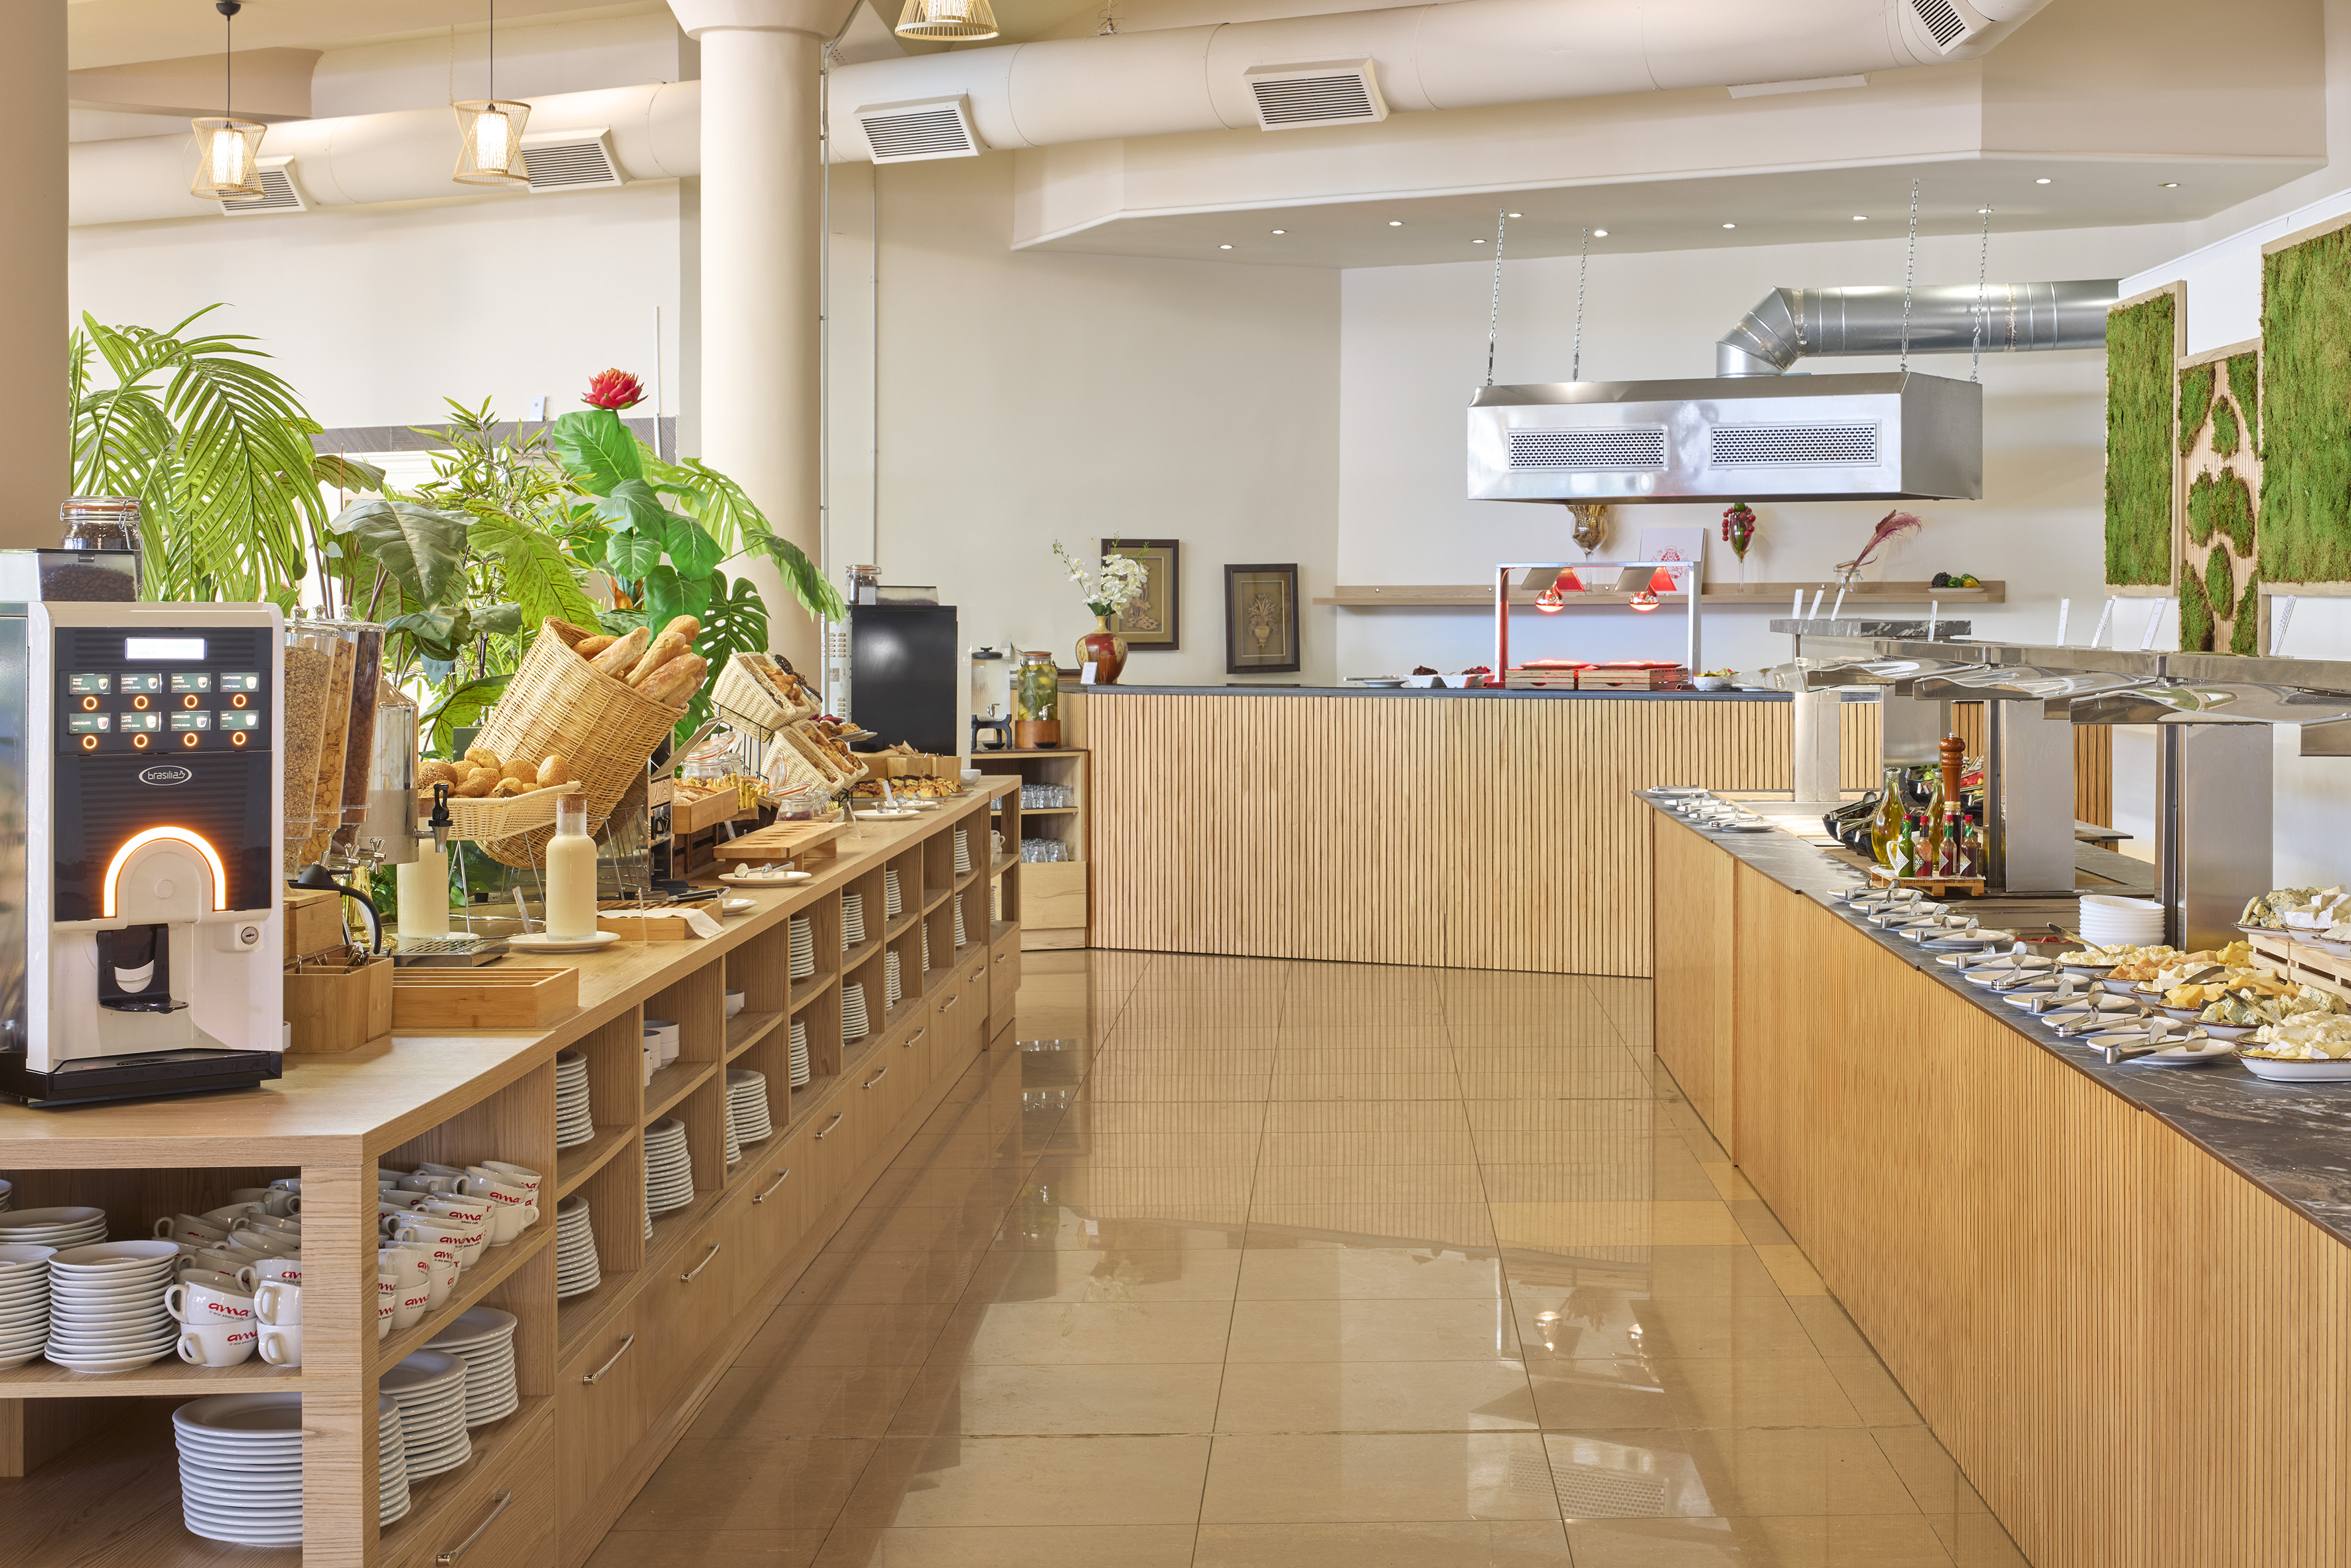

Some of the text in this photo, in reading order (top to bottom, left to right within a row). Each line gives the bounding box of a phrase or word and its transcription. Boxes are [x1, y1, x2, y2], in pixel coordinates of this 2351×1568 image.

[147, 770, 179, 780] brasilia
[490, 1192, 520, 1204] ama
[449, 1211, 482, 1221] ama
[208, 1303, 249, 1317] ama
